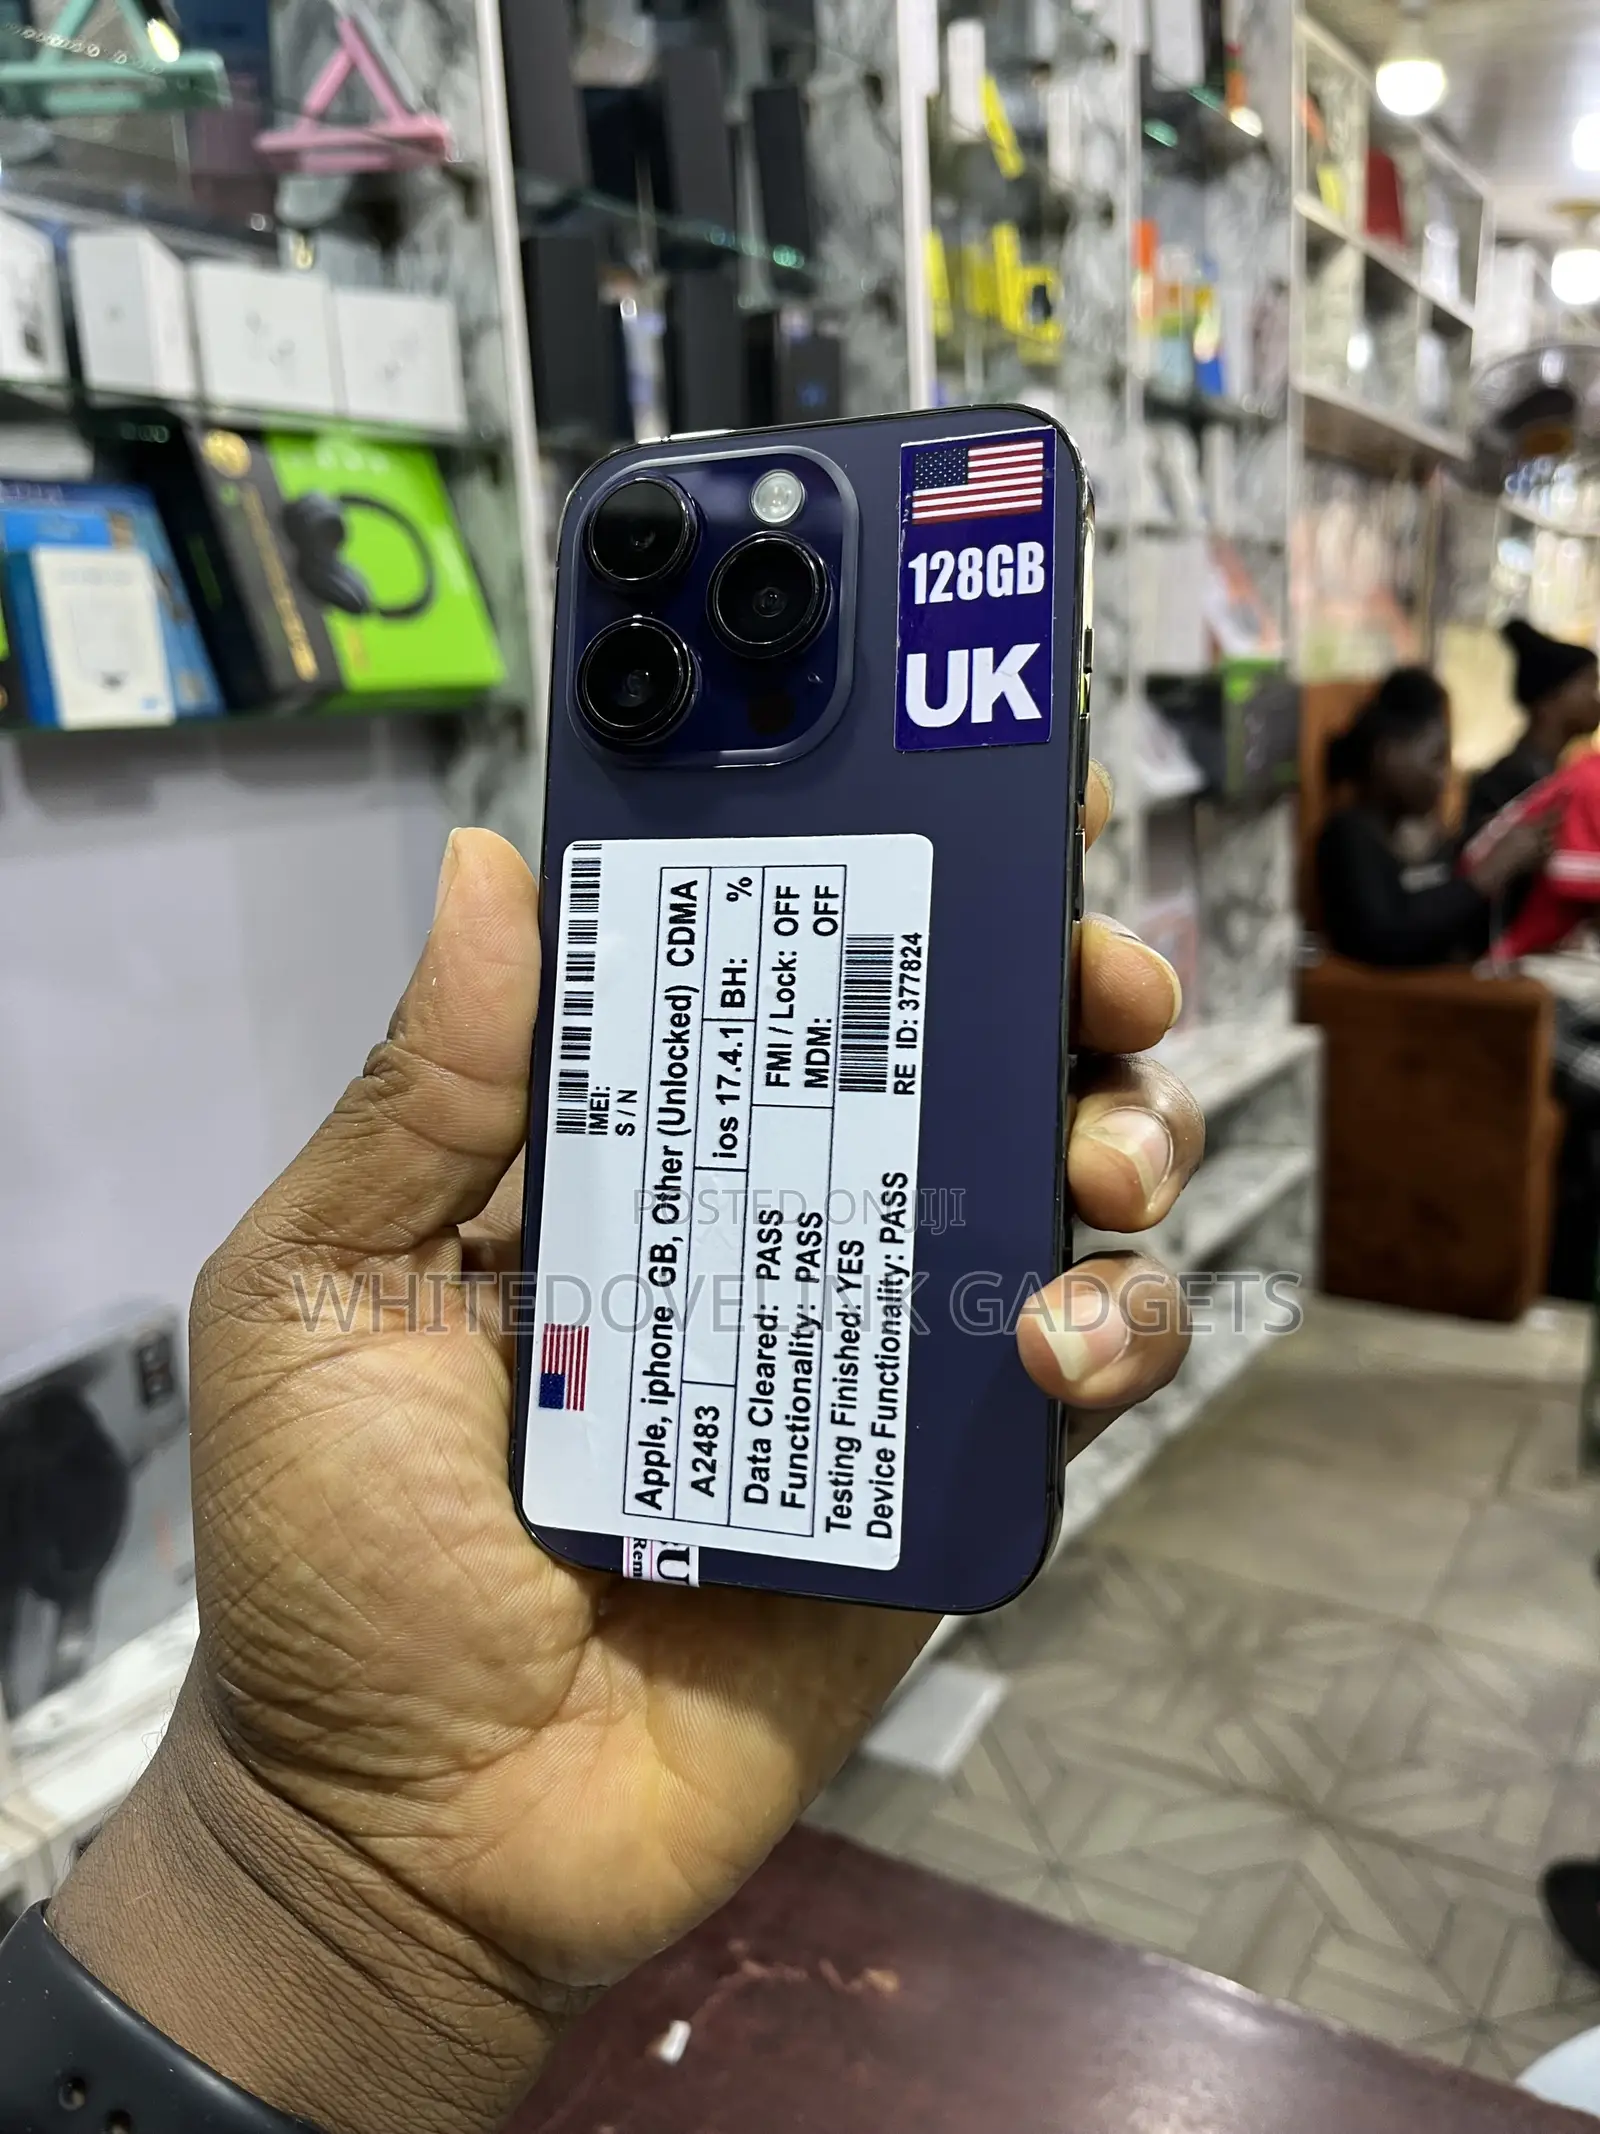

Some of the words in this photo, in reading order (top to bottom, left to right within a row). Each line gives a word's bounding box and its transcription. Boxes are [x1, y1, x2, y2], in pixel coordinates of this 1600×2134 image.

[907, 541, 1045, 605] 128GB
[905, 643, 1042, 729] UK
[666, 880, 698, 967] CDMA
[726, 876, 753, 902] %
[773, 885, 800, 937] OFF
[812, 884, 840, 937] OFF
[720, 958, 748, 1009] BH:
[769, 950, 797, 1019] Lock:
[897, 932, 923, 1012] 377824
[657, 985, 700, 1137] (Unlocked)
[715, 1027, 745, 1106] 17.4.1
[765, 1043, 792, 1088] FMI
[804, 1018, 832, 1089] MDM:
[896, 1018, 919, 1050] ID:
[589, 1086, 611, 1136] IMEI:
[893, 1063, 916, 1096] RE
[712, 1115, 739, 1159] ios
[651, 1144, 684, 1225] Other
[879, 1171, 909, 1244] PASS
[648, 1235, 684, 1288] GB,
[755, 1209, 784, 1281] PASS
[795, 1211, 824, 1284] PASS
[836, 1239, 865, 1294] YES
[640, 1305, 676, 1406] iphone
[747, 1304, 779, 1428] Cleared:
[830, 1303, 862, 1427] Finished:
[870, 1254, 911, 1439] Functionality:
[780, 1302, 823, 1509] Functionality:
[634, 1416, 673, 1511] Apple,
[690, 1405, 720, 1498] A2483
[743, 1437, 772, 1505] Data
[825, 1436, 862, 1534] Testing
[866, 1447, 896, 1539] Device
